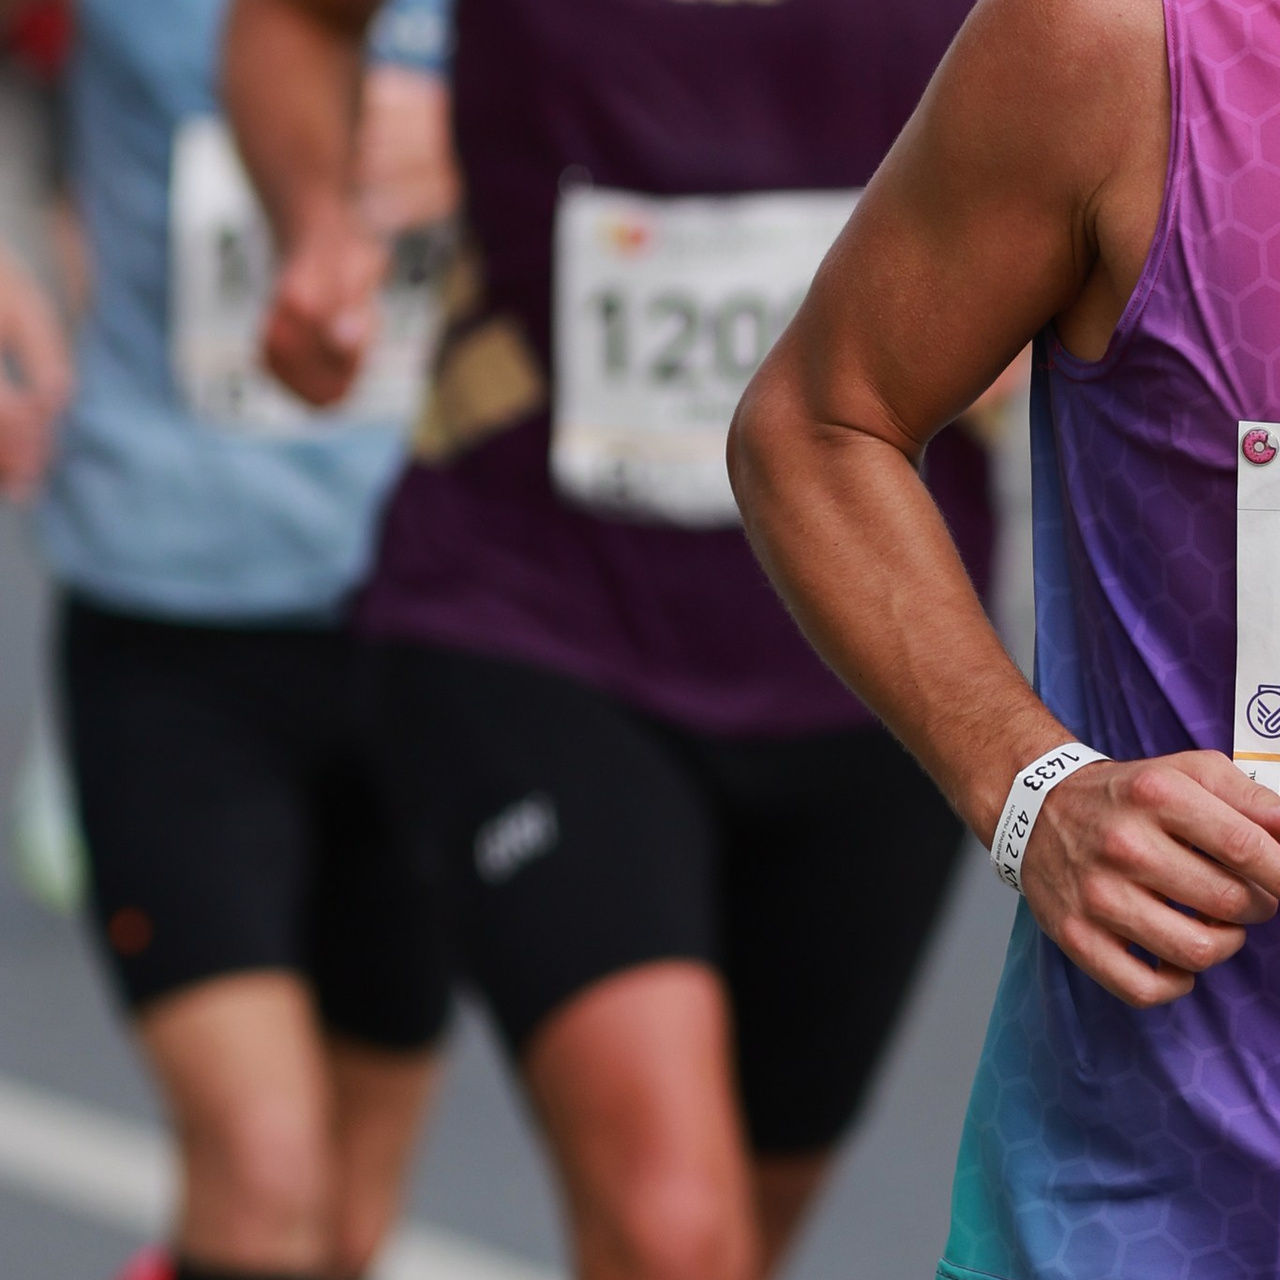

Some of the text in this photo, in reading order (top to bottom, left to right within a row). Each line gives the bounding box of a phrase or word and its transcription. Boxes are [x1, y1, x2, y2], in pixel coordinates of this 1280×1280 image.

[595, 288, 811, 382] 120
[1023, 751, 1080, 791] 1433
[1005, 810, 1029, 859] 42,2
